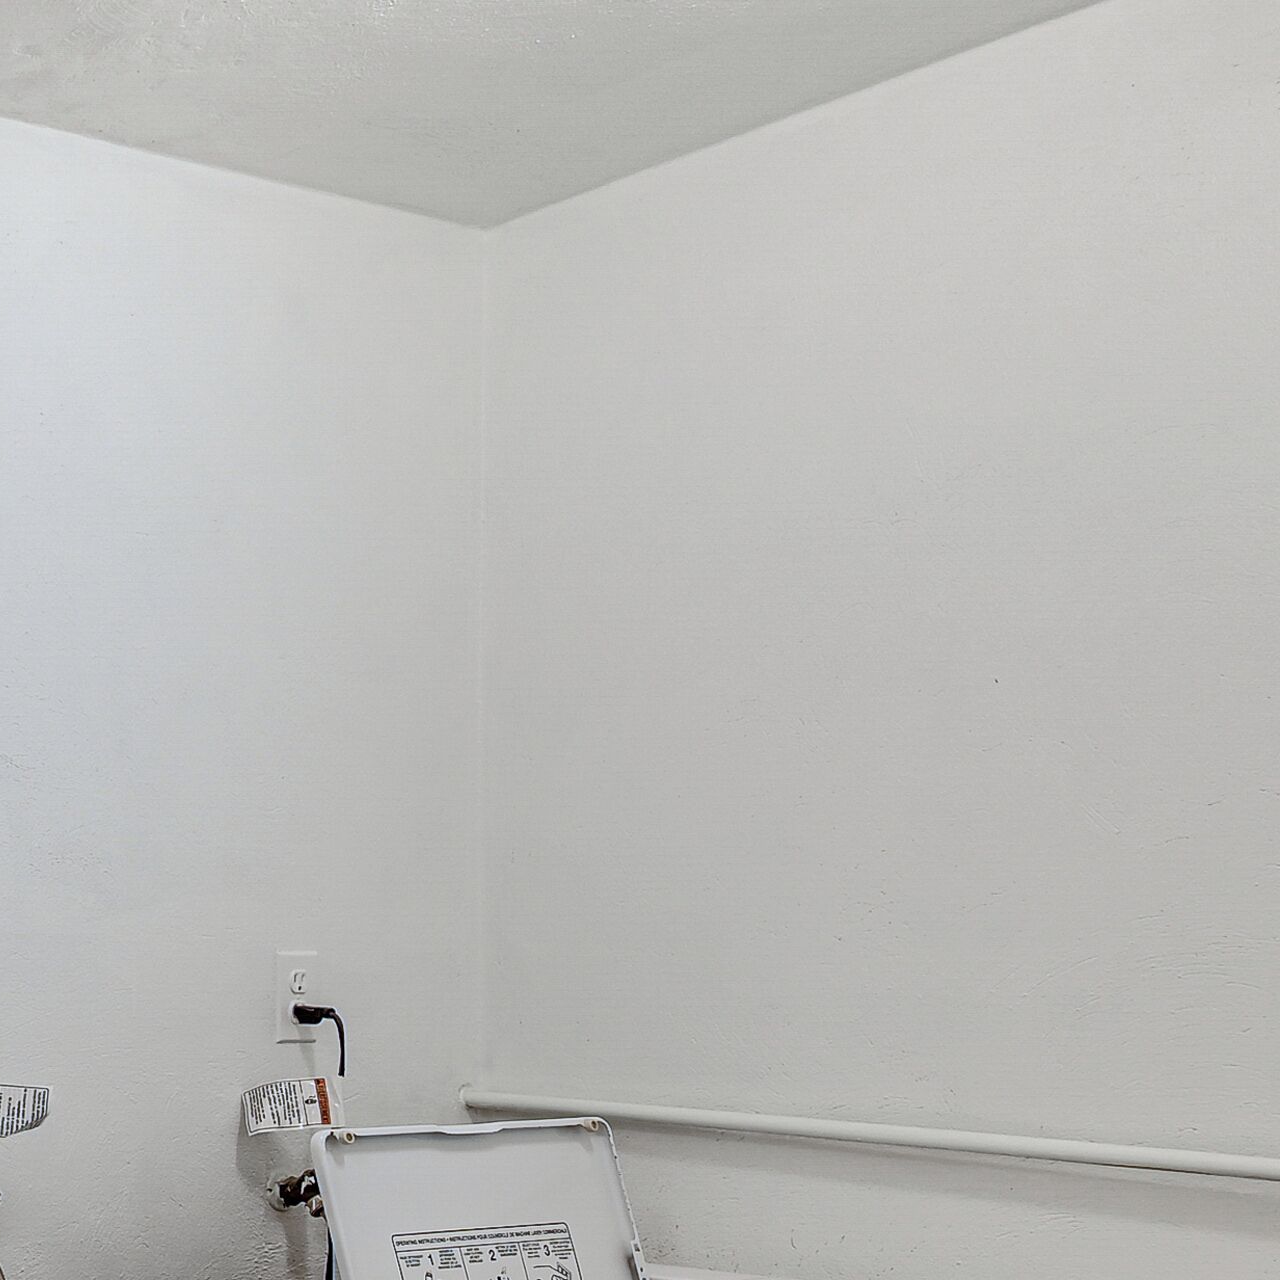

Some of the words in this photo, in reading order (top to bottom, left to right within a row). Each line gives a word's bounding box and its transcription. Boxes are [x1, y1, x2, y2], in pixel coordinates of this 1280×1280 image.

[489, 1250, 496, 1261] 2
[543, 1245, 550, 1256] 3
[428, 1254, 434, 1265] 1
